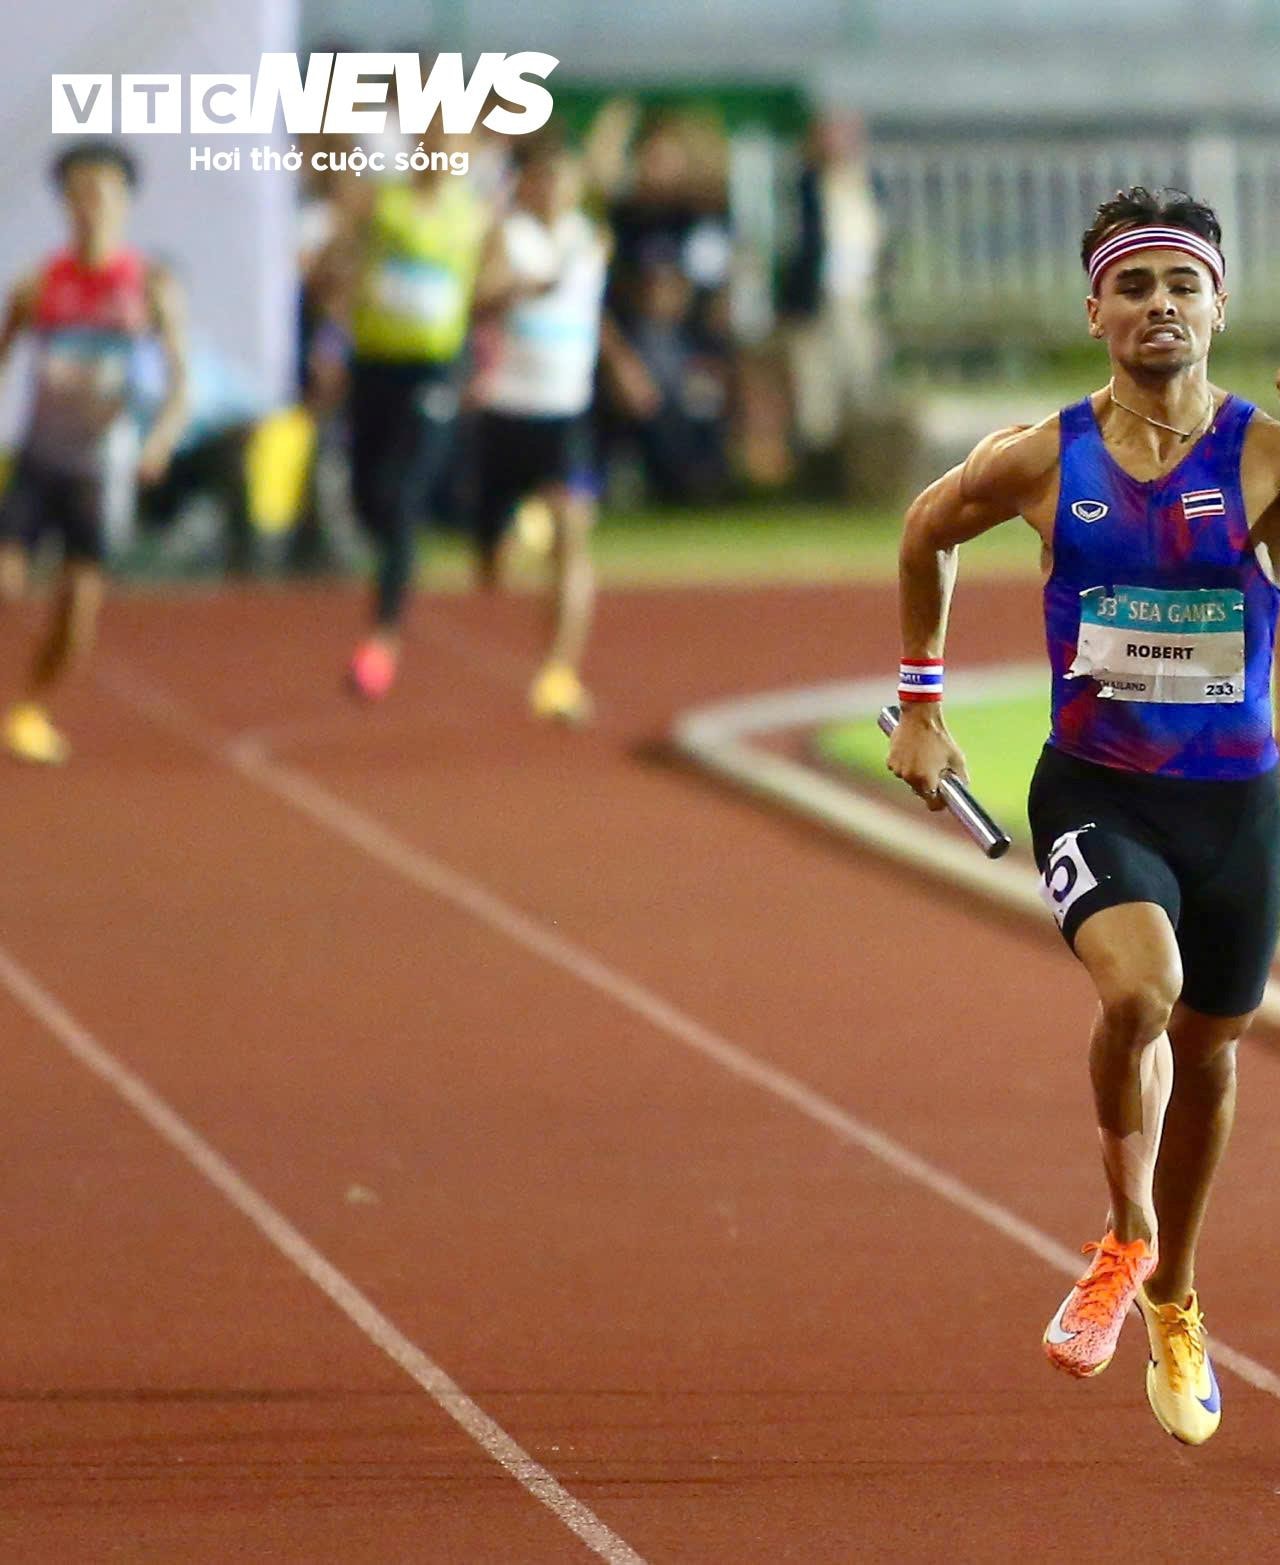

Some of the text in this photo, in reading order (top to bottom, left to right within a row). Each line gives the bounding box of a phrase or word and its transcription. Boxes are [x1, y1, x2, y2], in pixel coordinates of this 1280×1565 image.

[1128, 600, 1161, 623] SEA
[1168, 603, 1226, 624] GAMES
[1126, 644, 1194, 660] ROBERT
[1206, 683, 1234, 696] 233
